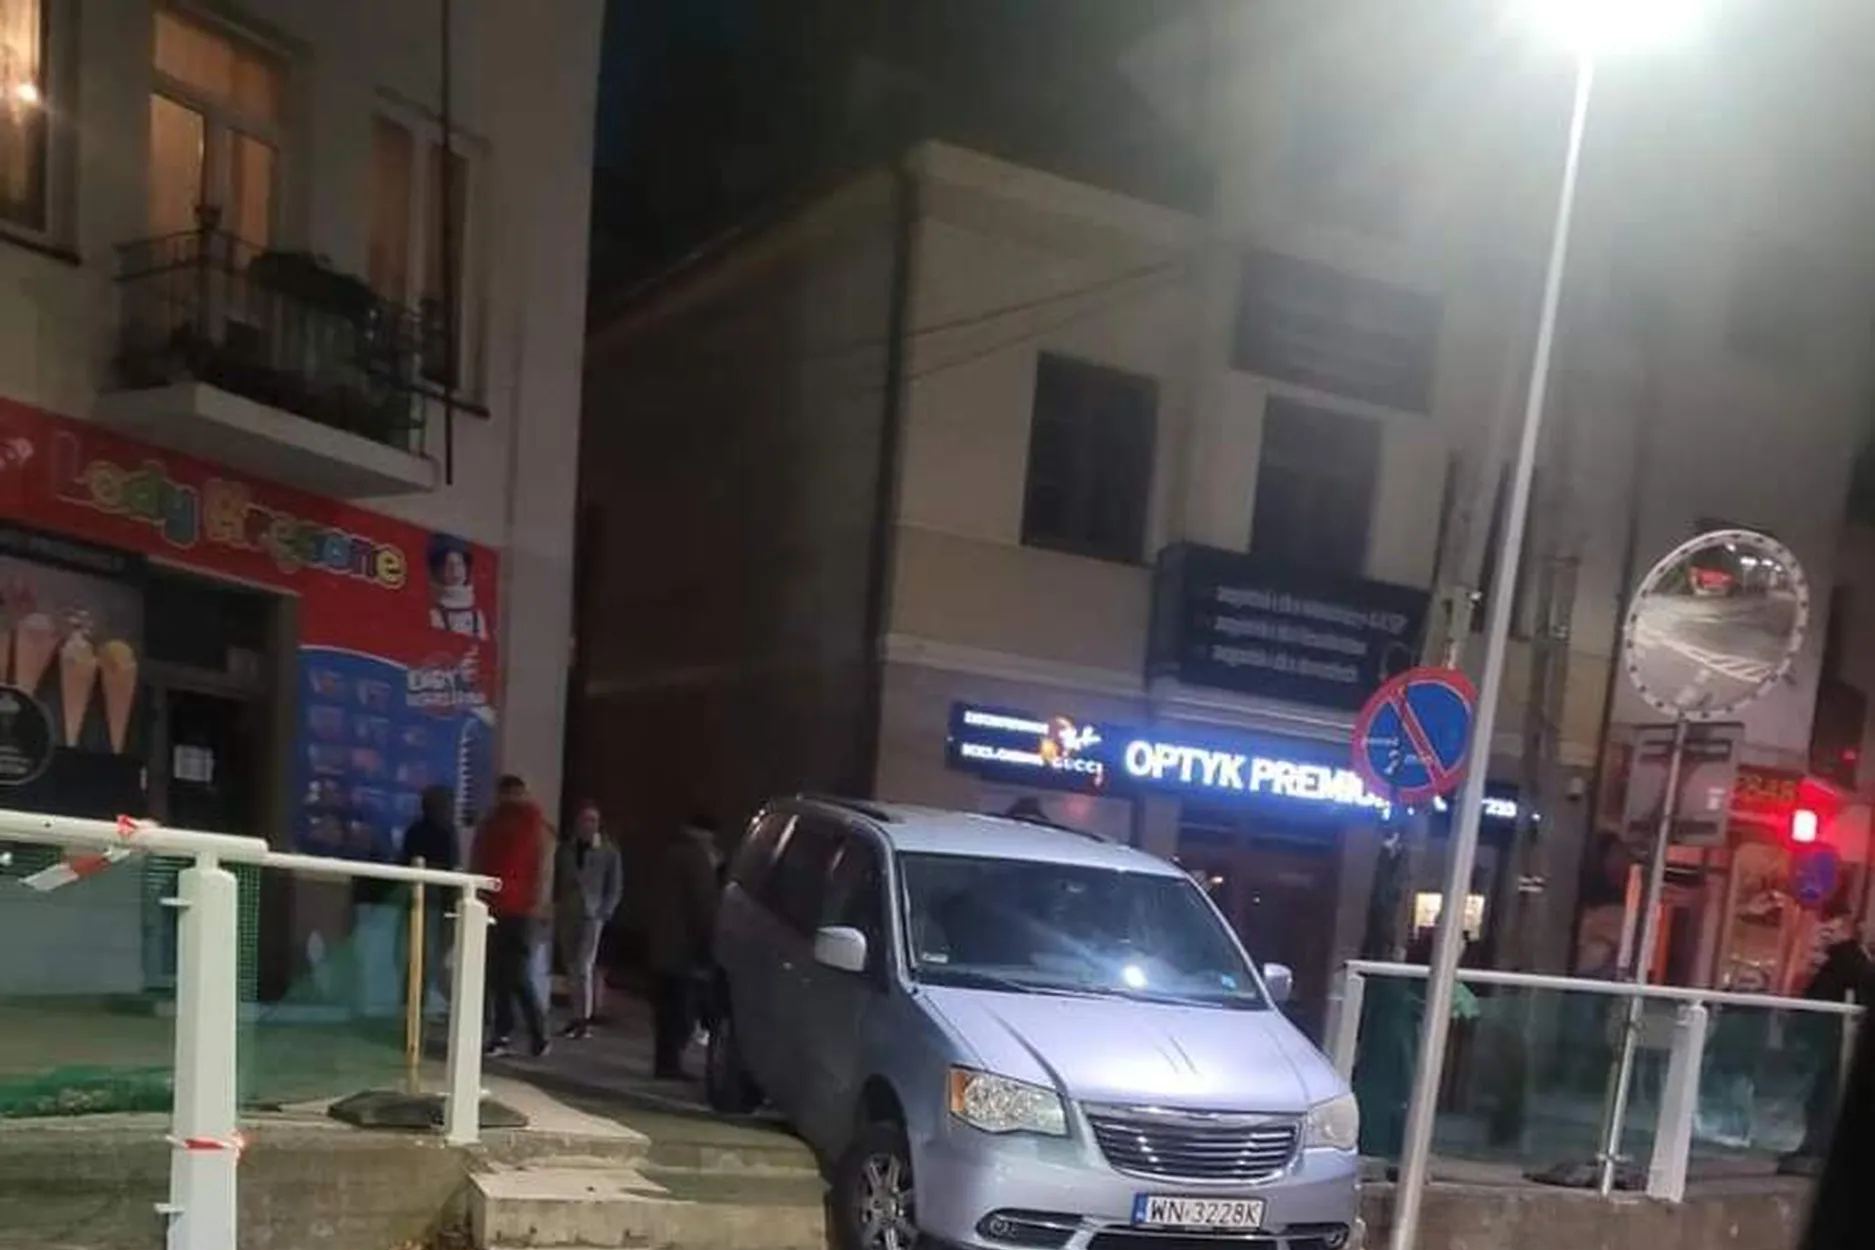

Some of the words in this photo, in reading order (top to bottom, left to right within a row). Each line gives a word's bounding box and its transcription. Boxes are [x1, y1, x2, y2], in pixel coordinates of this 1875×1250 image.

[1125, 739, 1246, 790] OPTYK
[1150, 1199, 1186, 1223] WN
[1190, 1201, 1262, 1227] 3228K
